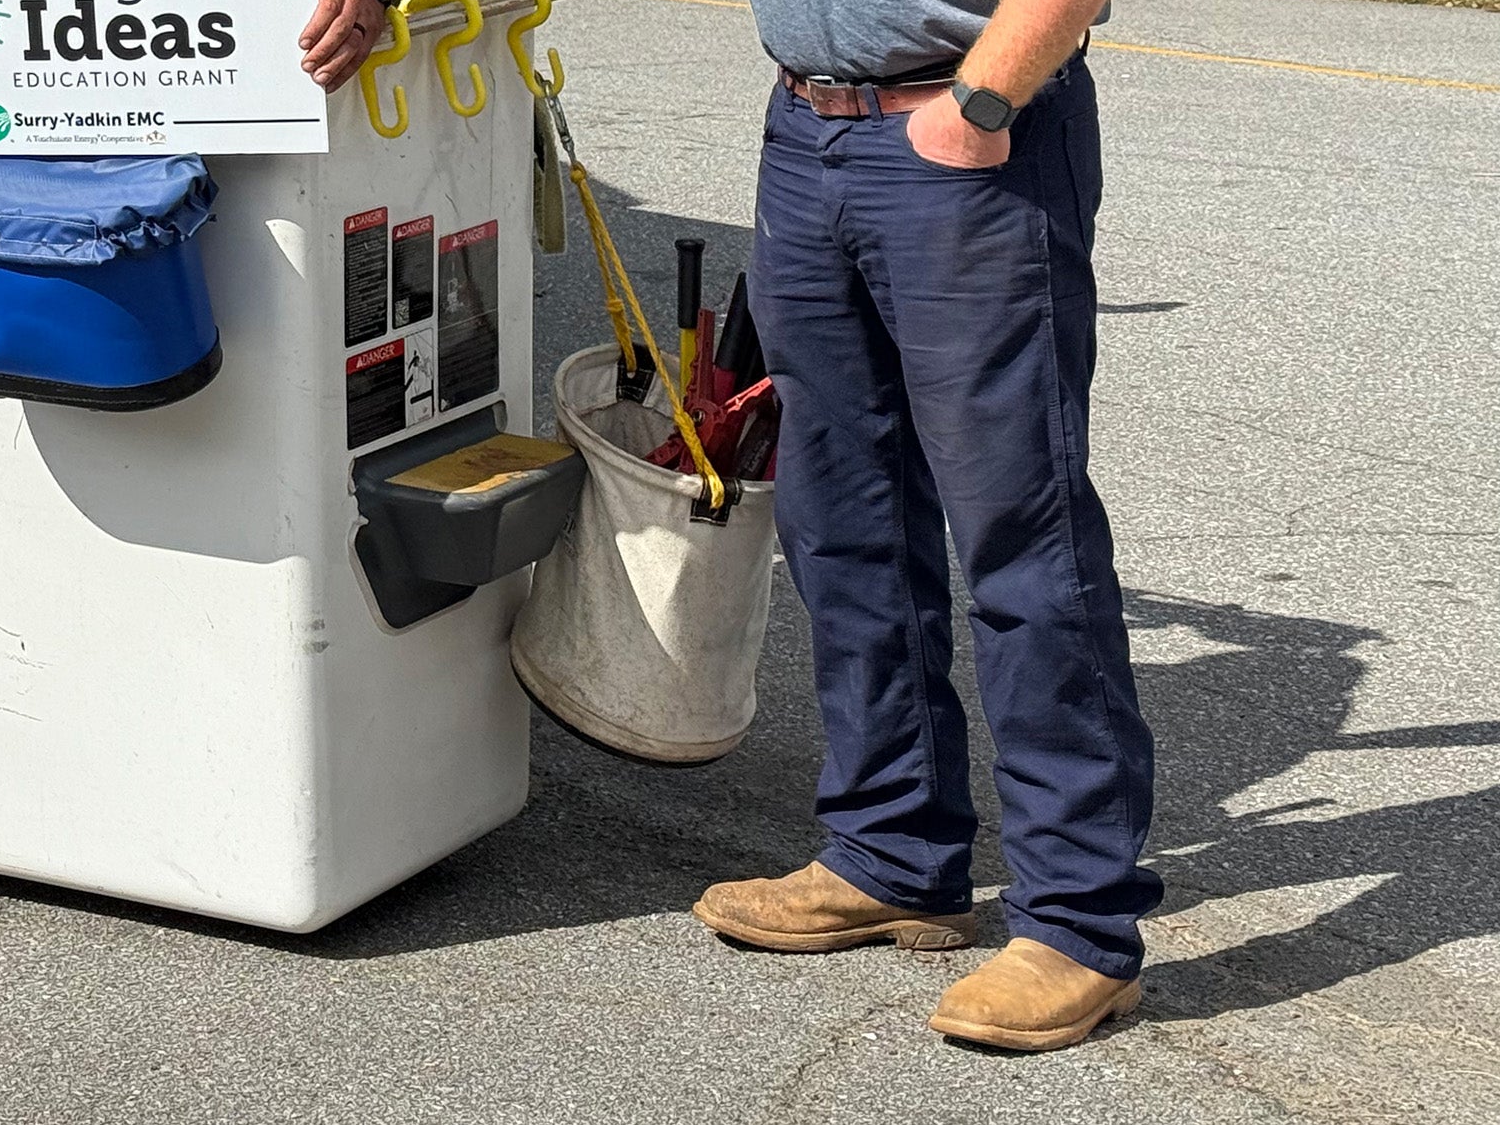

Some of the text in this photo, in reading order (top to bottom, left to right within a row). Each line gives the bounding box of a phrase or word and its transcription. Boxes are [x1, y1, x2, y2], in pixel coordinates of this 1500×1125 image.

[13, 69, 238, 88] EDUCATION GRANT
[14, 111, 165, 130] Surry-Yadkin EMC
[355, 210, 383, 225] DANGER
[401, 219, 431, 236] DANGER
[457, 227, 486, 245] DANGER
[361, 344, 395, 366] DANGER
